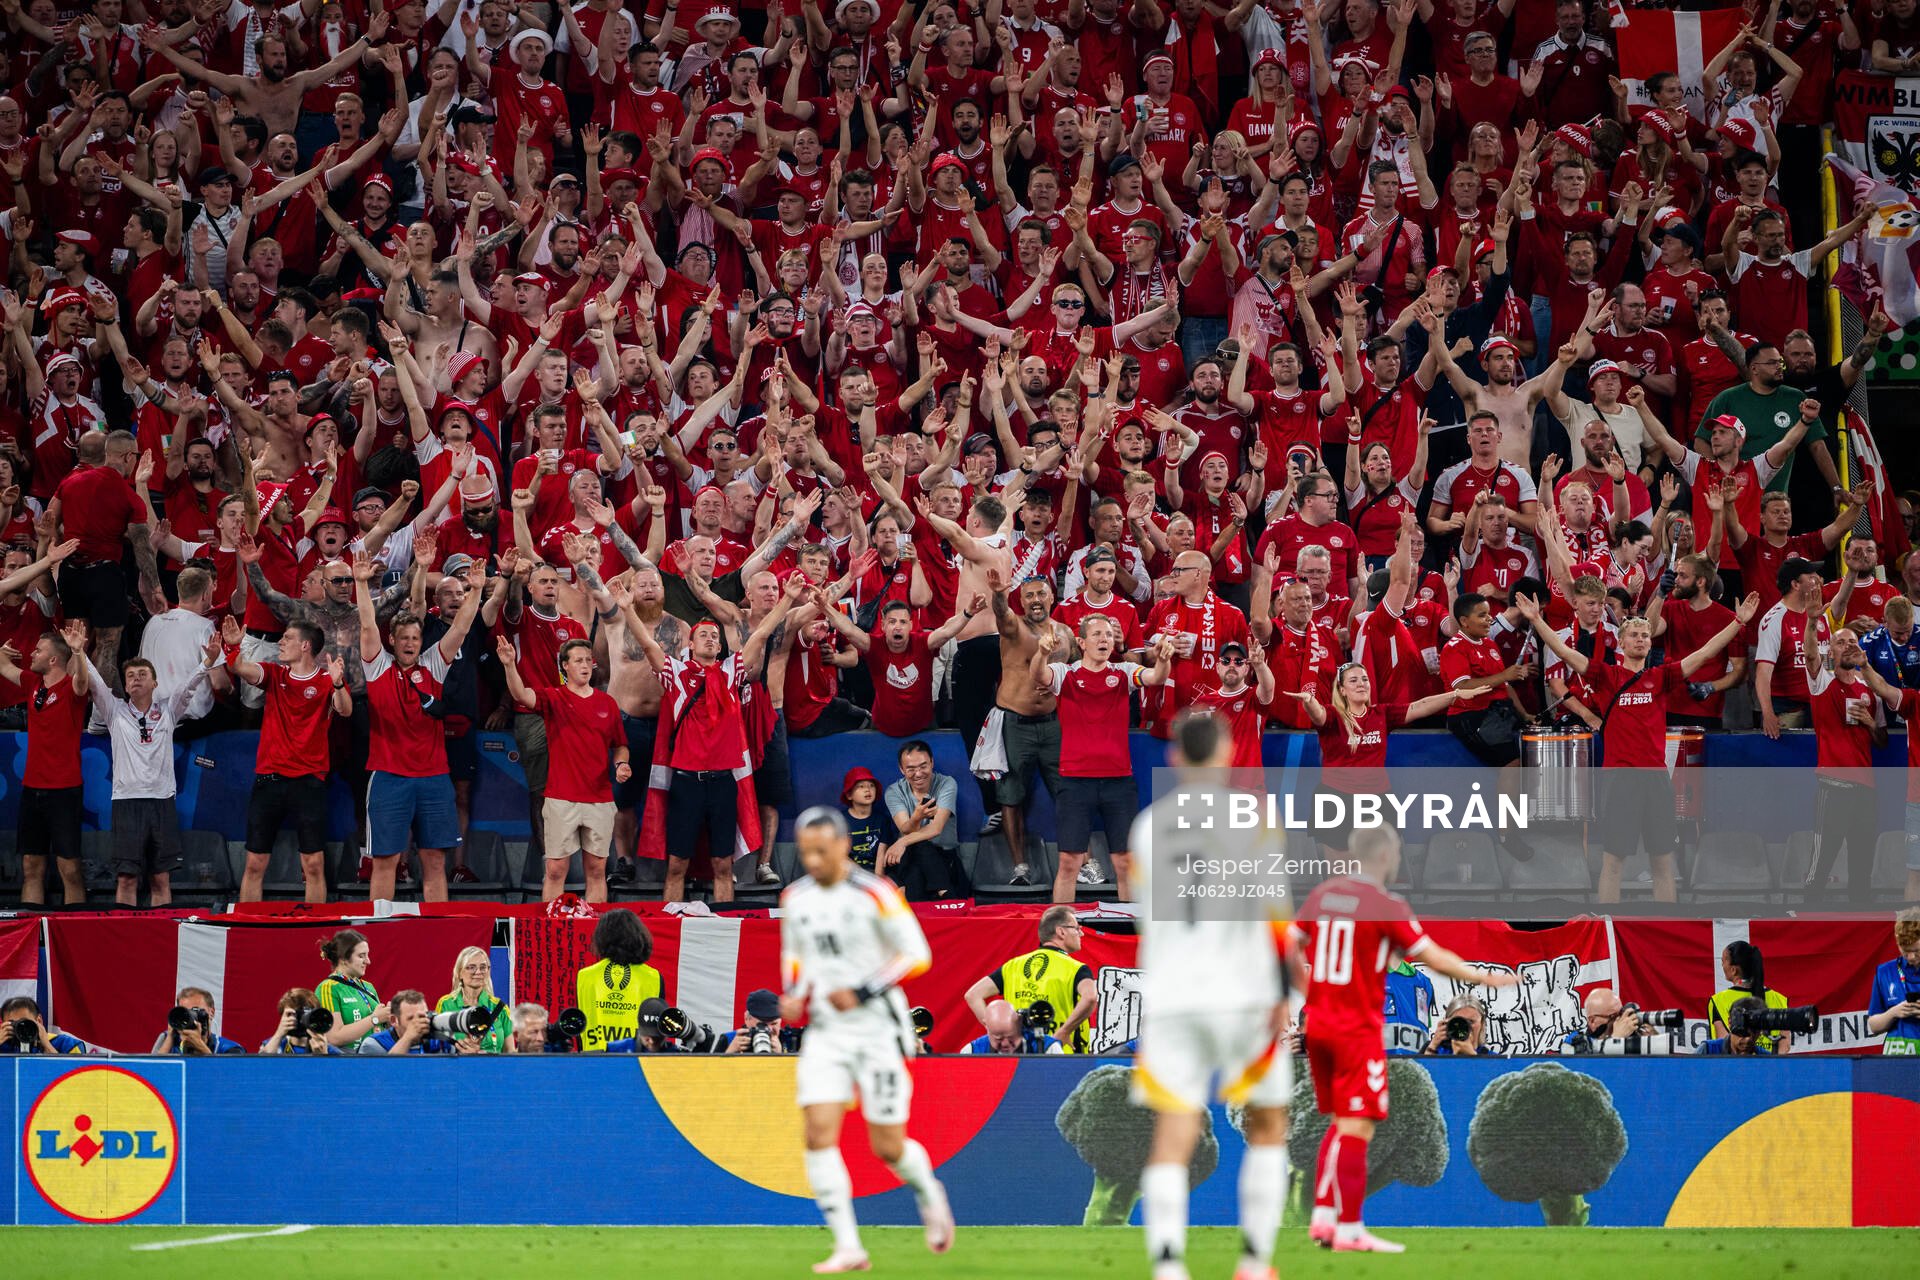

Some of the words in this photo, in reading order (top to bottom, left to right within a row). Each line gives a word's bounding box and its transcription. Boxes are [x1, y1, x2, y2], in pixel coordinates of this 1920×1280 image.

[1021, 47, 1031, 62] 9
[1873, 119, 1889, 127] AFC
[1361, 735, 1382, 744] 2024
[1313, 916, 1355, 985] 10
[1394, 1026, 1421, 1050] ICT
